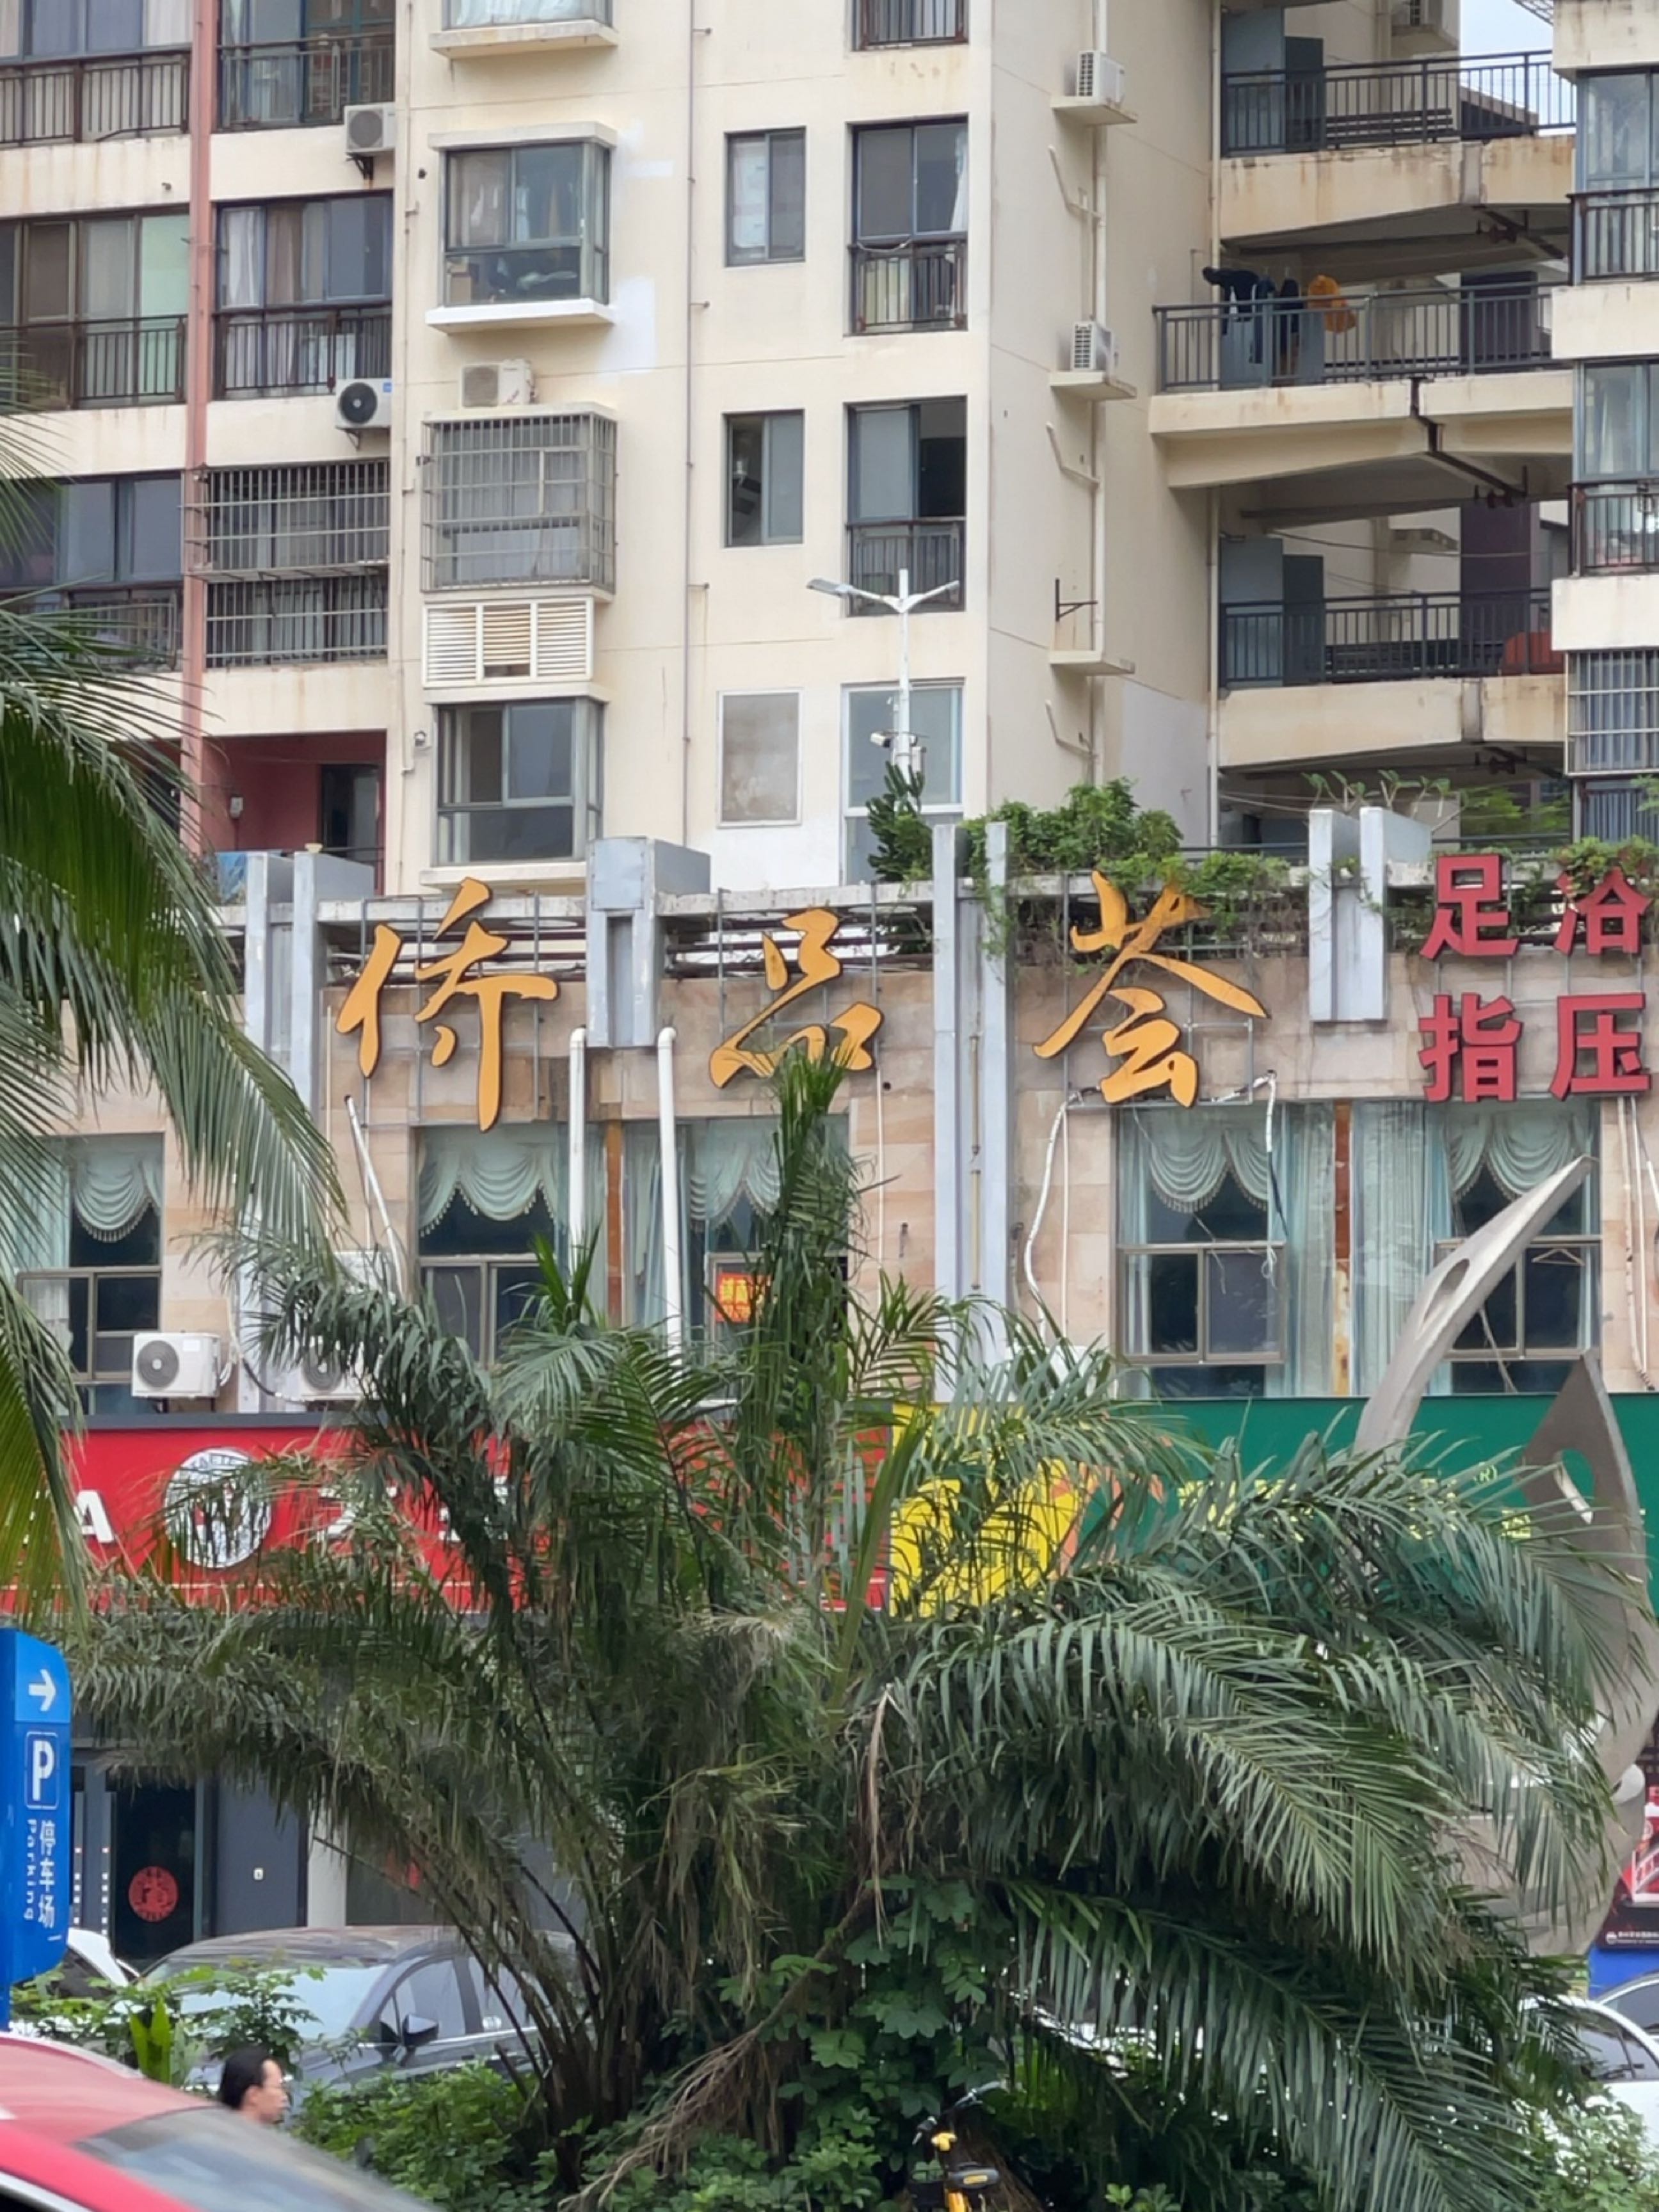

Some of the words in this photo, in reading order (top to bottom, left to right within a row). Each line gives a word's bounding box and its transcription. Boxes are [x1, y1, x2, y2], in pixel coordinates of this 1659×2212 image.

[1418, 993, 1653, 1102] 指压
[33, 1740, 55, 1801] P
[38, 1820, 56, 1928] 停车场
